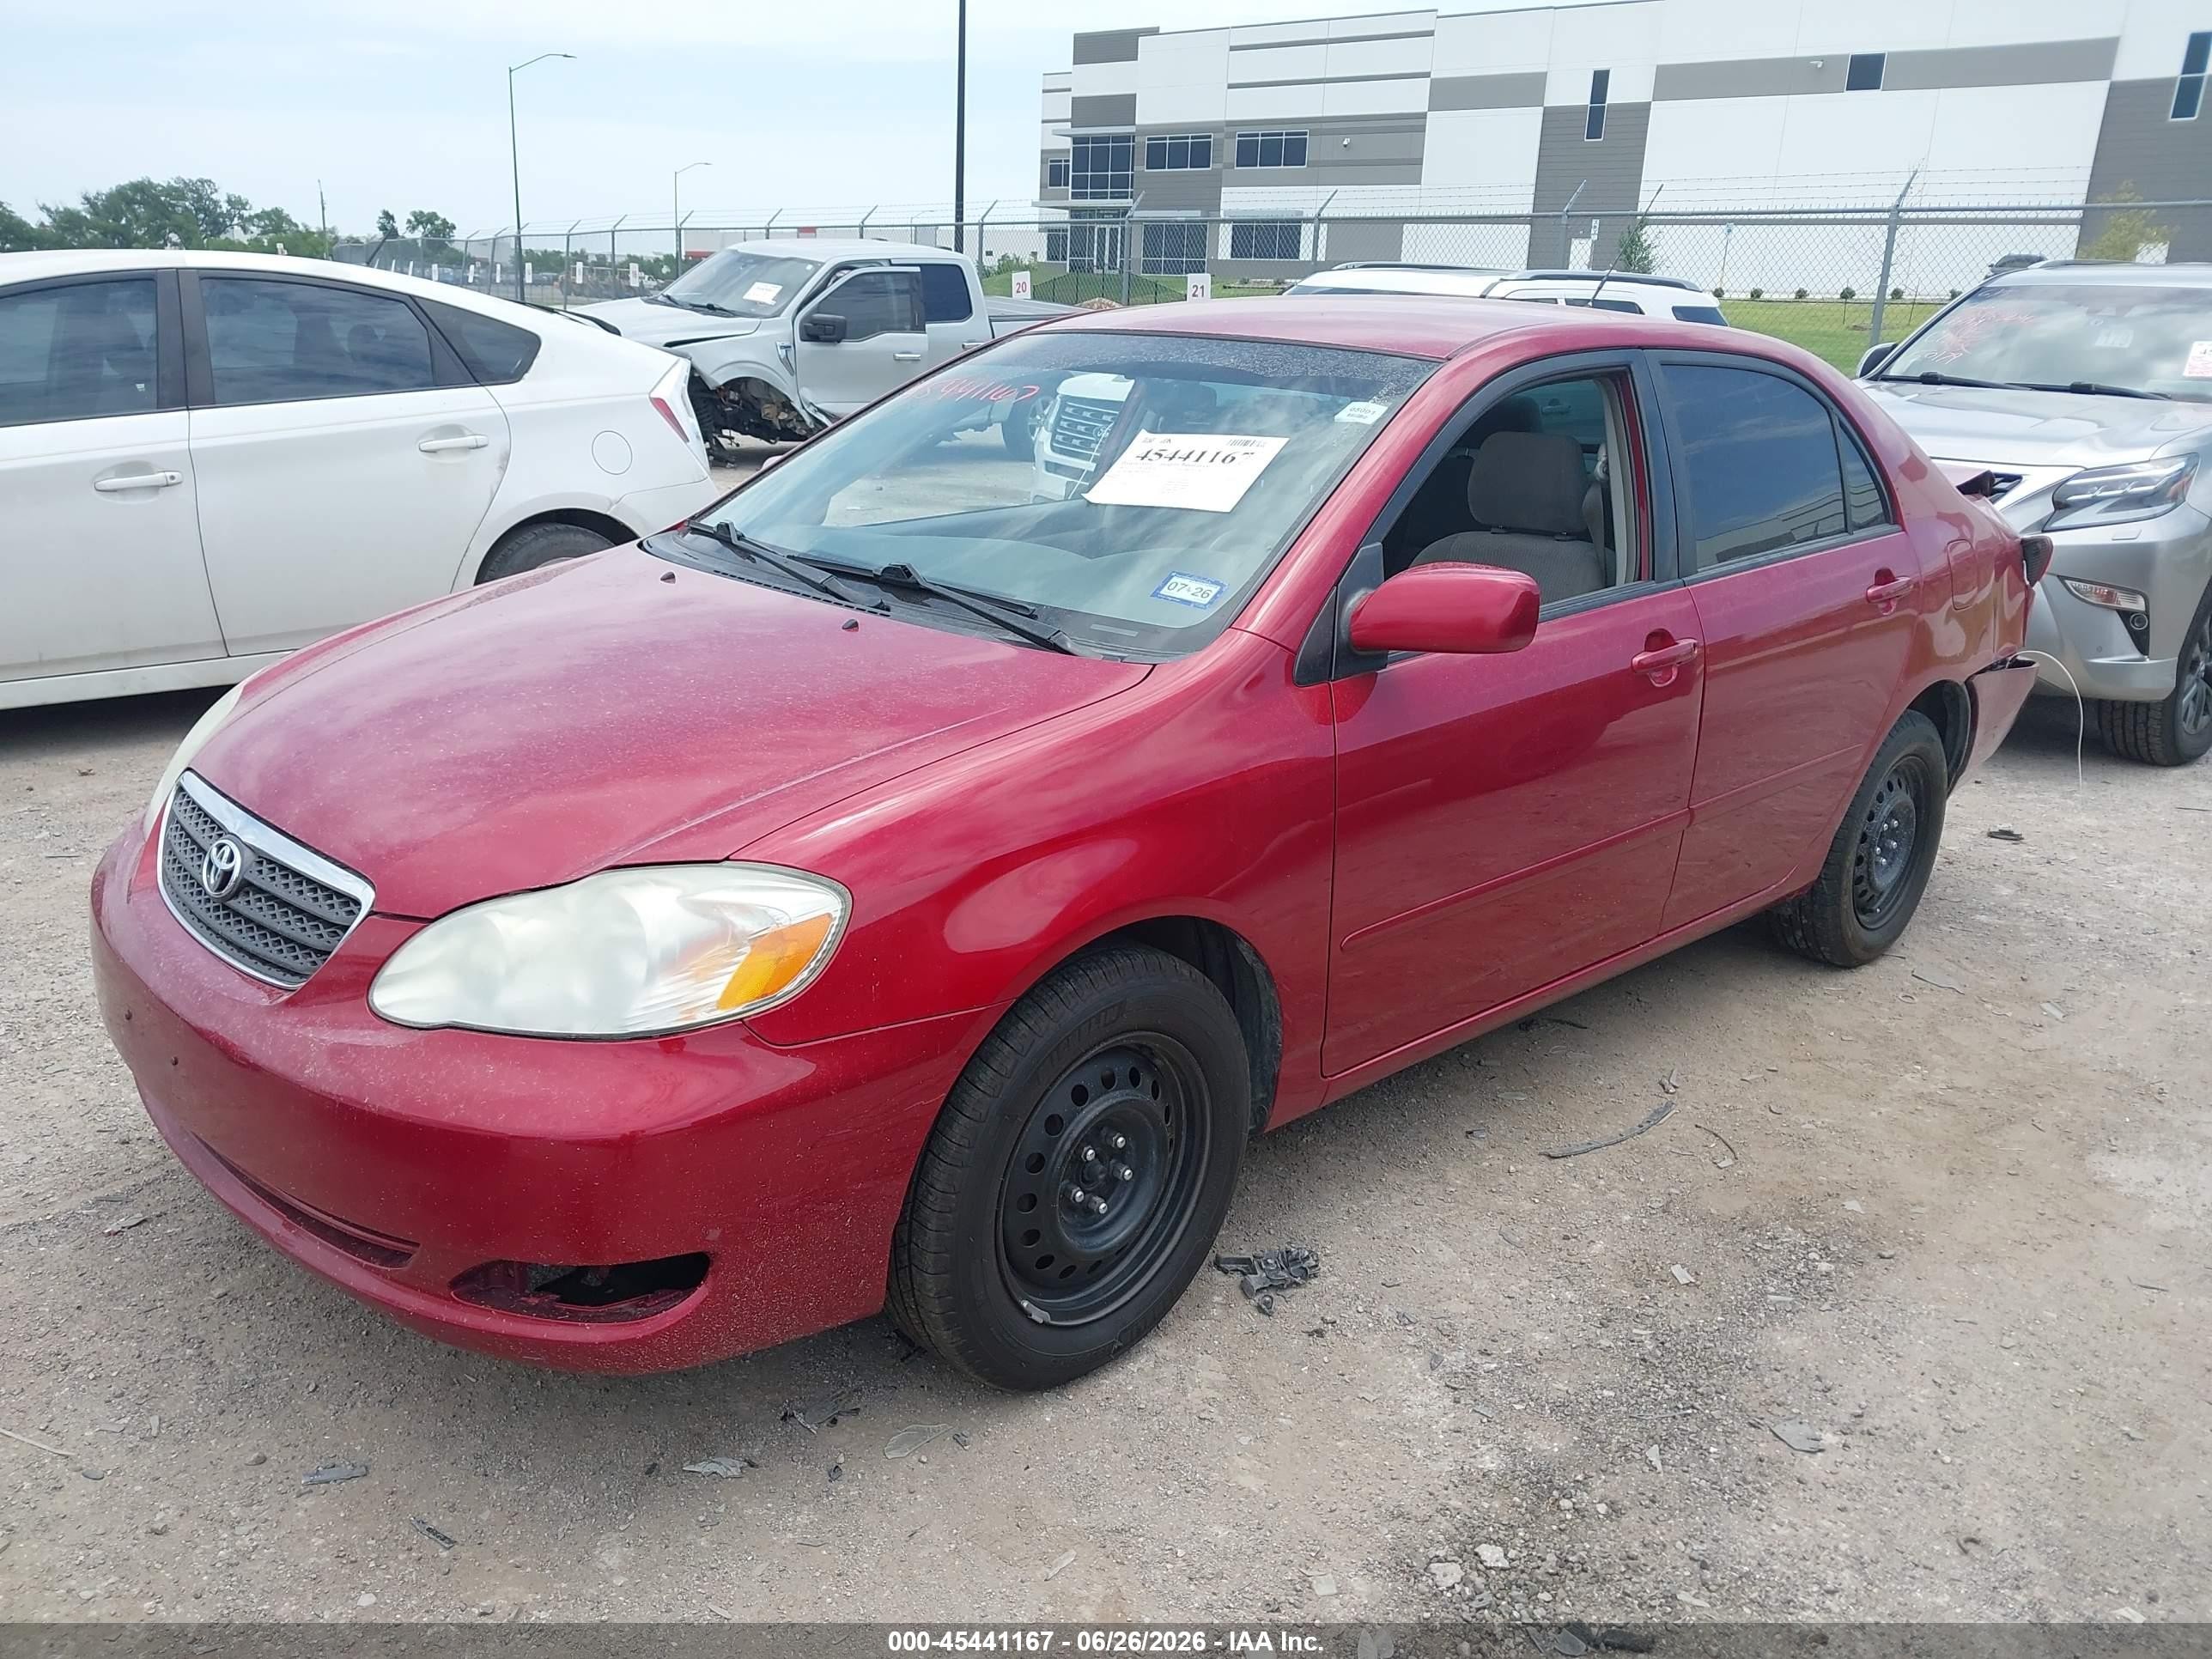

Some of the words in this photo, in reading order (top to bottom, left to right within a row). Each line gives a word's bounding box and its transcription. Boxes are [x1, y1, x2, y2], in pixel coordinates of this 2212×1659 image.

[1016, 282, 1027, 294] 20
[1192, 284, 1205, 298] 21
[1167, 581, 1188, 592] 07
[1190, 586, 1212, 599] 26
